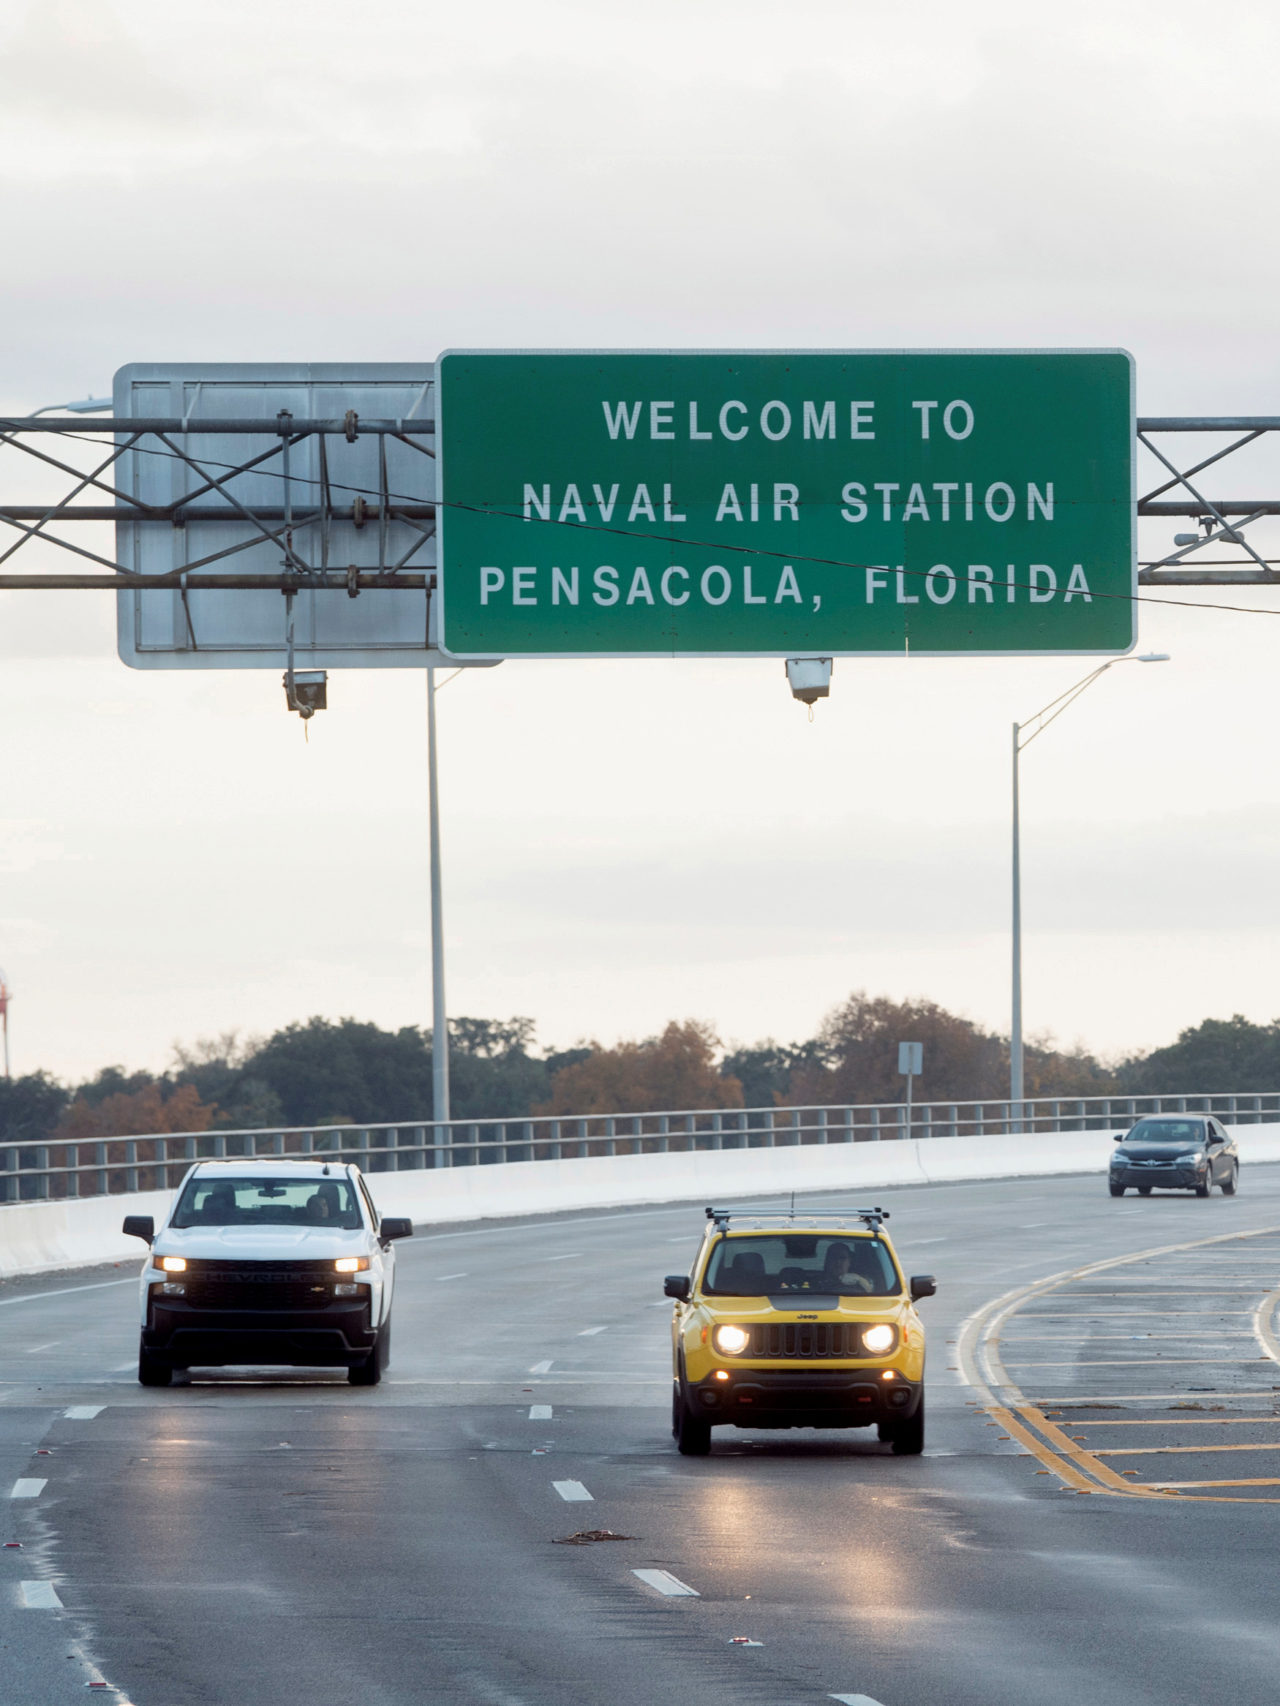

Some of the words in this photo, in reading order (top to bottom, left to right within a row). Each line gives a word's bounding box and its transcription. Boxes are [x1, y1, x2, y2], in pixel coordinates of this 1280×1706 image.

[602, 400, 875, 441] WELCOME
[912, 399, 974, 441] TO
[523, 484, 687, 523] NAVAL
[716, 483, 799, 522] AIR
[841, 482, 1054, 523] STATION
[480, 565, 822, 613] PENSACOLA,
[866, 564, 1093, 605] FLORIDA
[191, 1273, 328, 1283] CHEVROLET
[796, 1313, 818, 1321] Jeep
